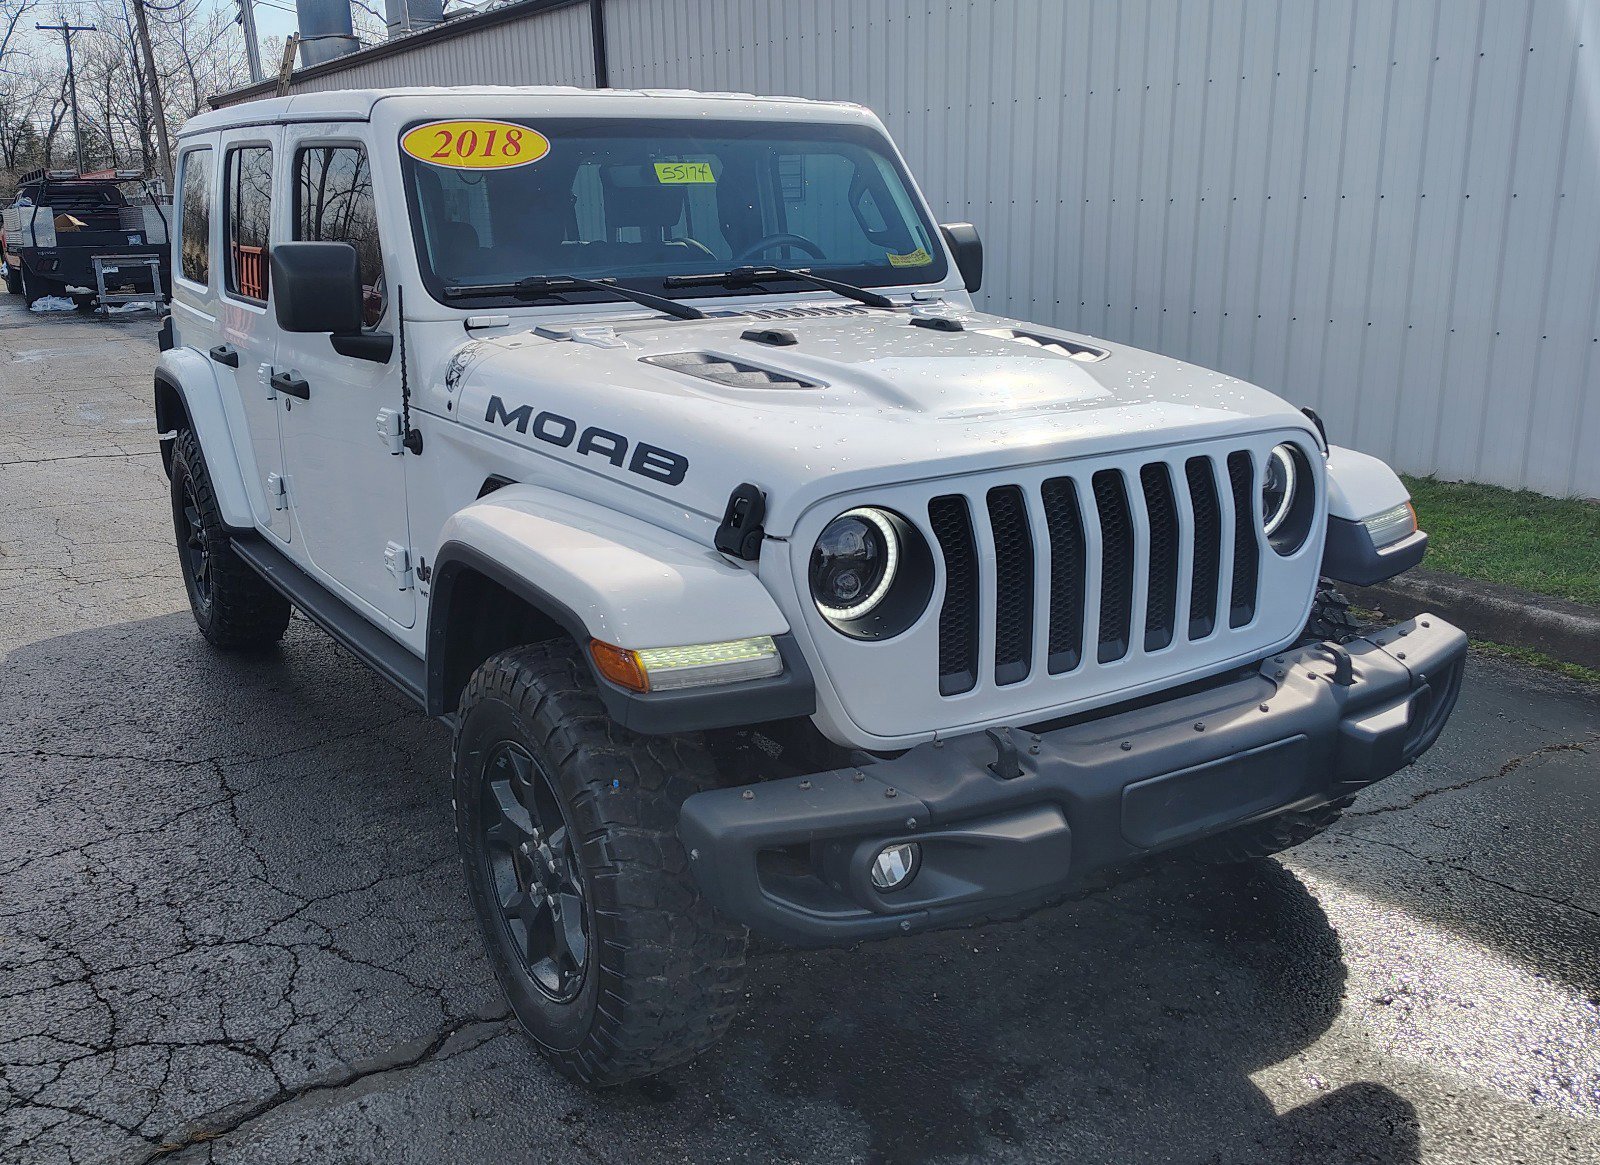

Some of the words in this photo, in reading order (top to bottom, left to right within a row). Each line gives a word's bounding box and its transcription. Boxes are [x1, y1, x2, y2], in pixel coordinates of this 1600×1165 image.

[431, 129, 523, 158] 2018
[662, 163, 707, 181] 55174
[485, 394, 689, 487] MOAB
[416, 555, 431, 585] Je
